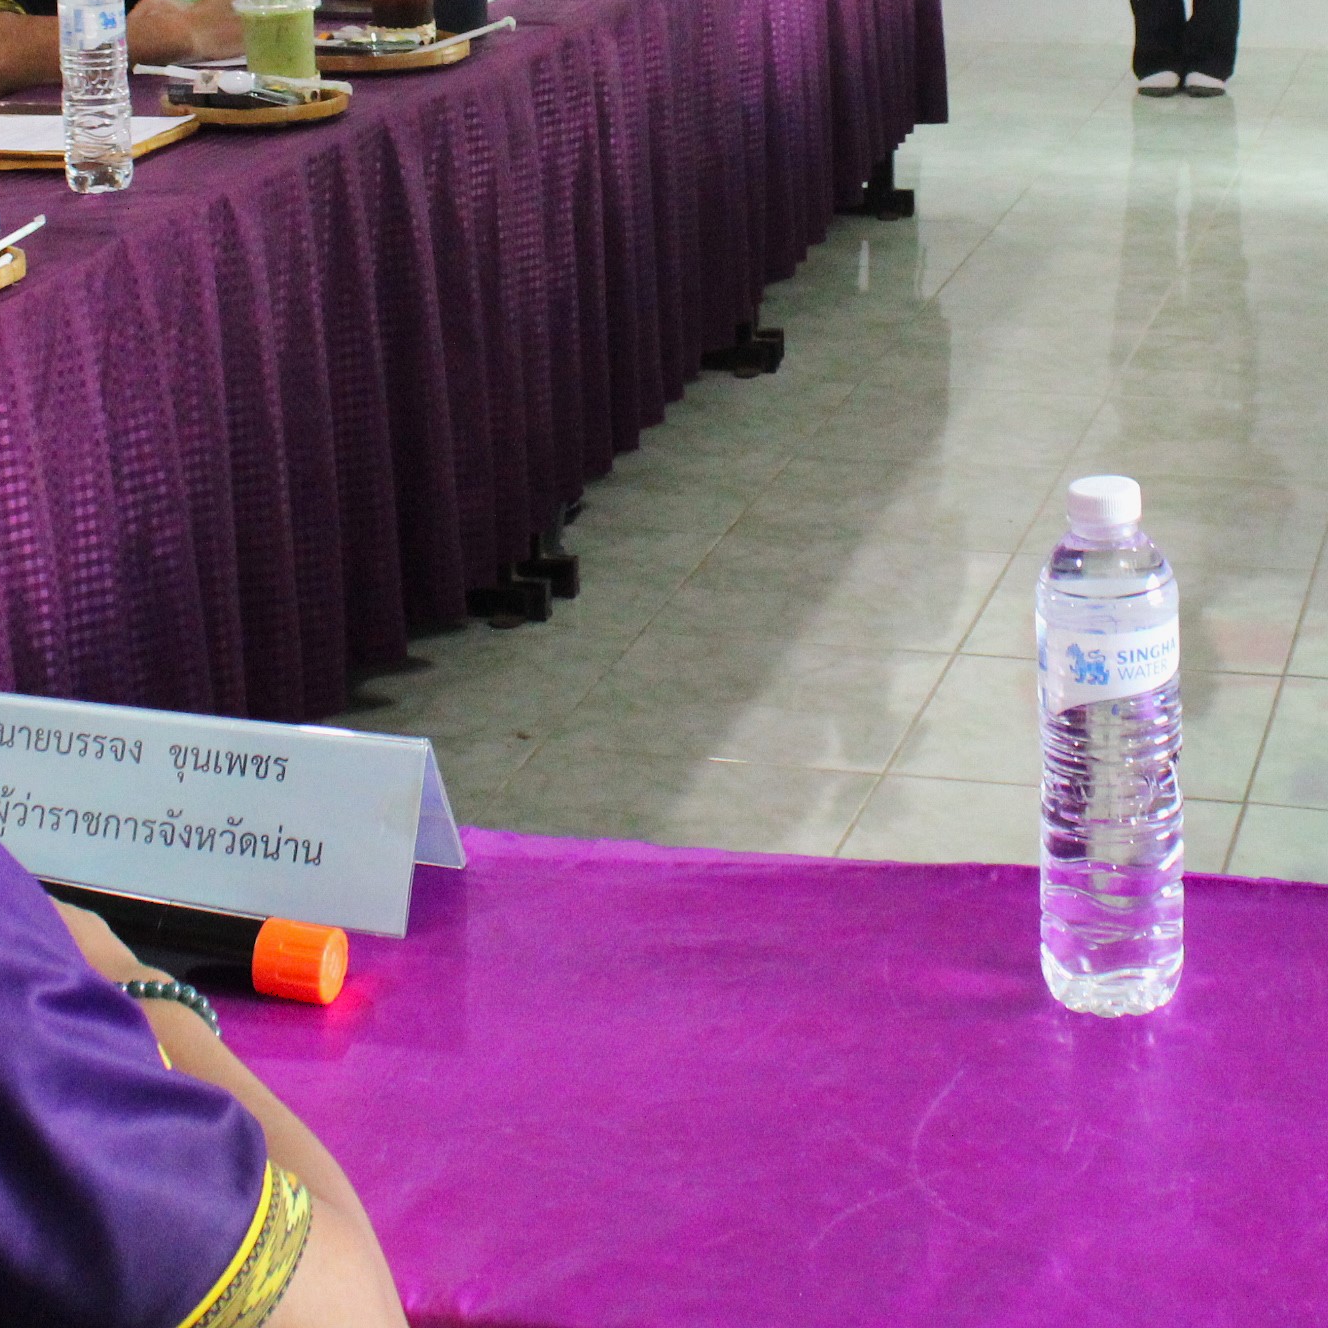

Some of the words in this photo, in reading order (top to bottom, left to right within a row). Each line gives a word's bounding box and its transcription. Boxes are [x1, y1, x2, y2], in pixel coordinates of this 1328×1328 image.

[1116, 637, 1176, 665] SINGHA
[1116, 658, 1168, 681] WATER
[168, 742, 289, 783] ขุนเพชร
